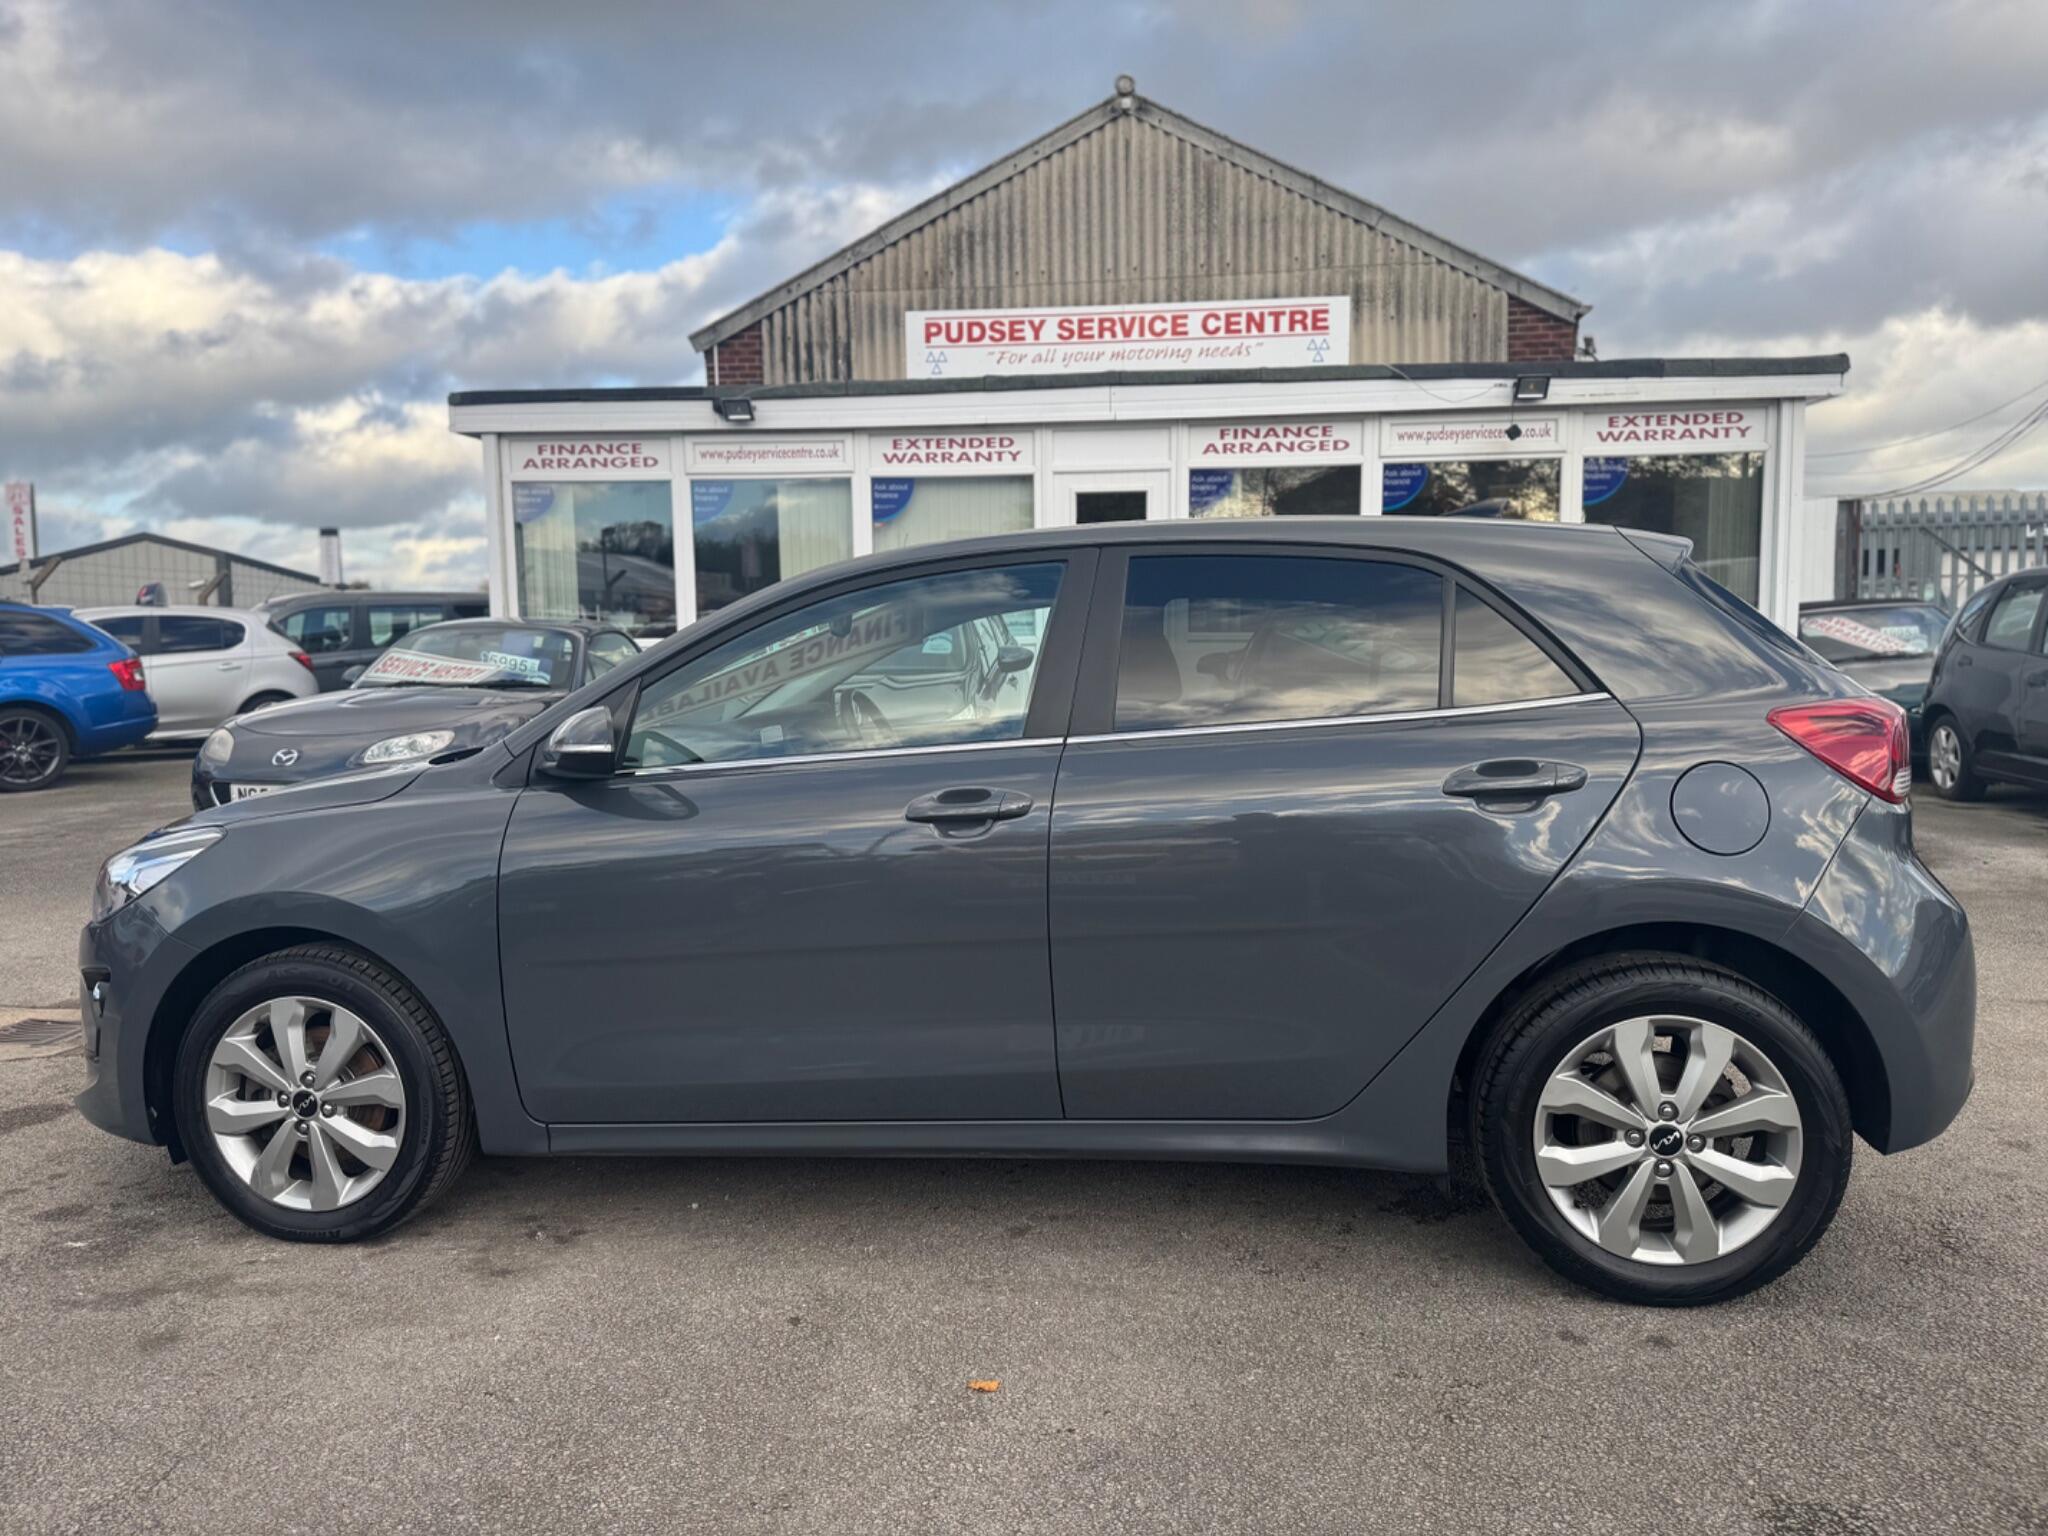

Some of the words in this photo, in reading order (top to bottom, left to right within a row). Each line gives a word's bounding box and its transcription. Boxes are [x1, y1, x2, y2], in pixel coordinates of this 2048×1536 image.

[924, 319, 1046, 344] PUDSEY
[1057, 314, 1189, 341] SERVICE
[1201, 309, 1330, 336] CENTRE
[1031, 348, 1056, 364] all
[1062, 349, 1105, 368] your
[1109, 345, 1193, 364] motoring
[1607, 411, 1744, 428] EXTENDED
[1219, 425, 1333, 440] FINANCE
[1397, 422, 1552, 445] www.pudseyservicece.co.uk
[1596, 425, 1752, 442] WARRANTY
[537, 442, 643, 456] FINANCE
[892, 436, 1015, 450] EXTENDED
[1202, 439, 1350, 455] ARRANGED
[698, 442, 840, 464] www.pudseyservicecentre.co.uk
[882, 450, 1022, 464] WARRANTY
[522, 456, 659, 469] ARRANGED
[1400, 468, 1421, 476] about
[375, 655, 433, 677] SERVICE
